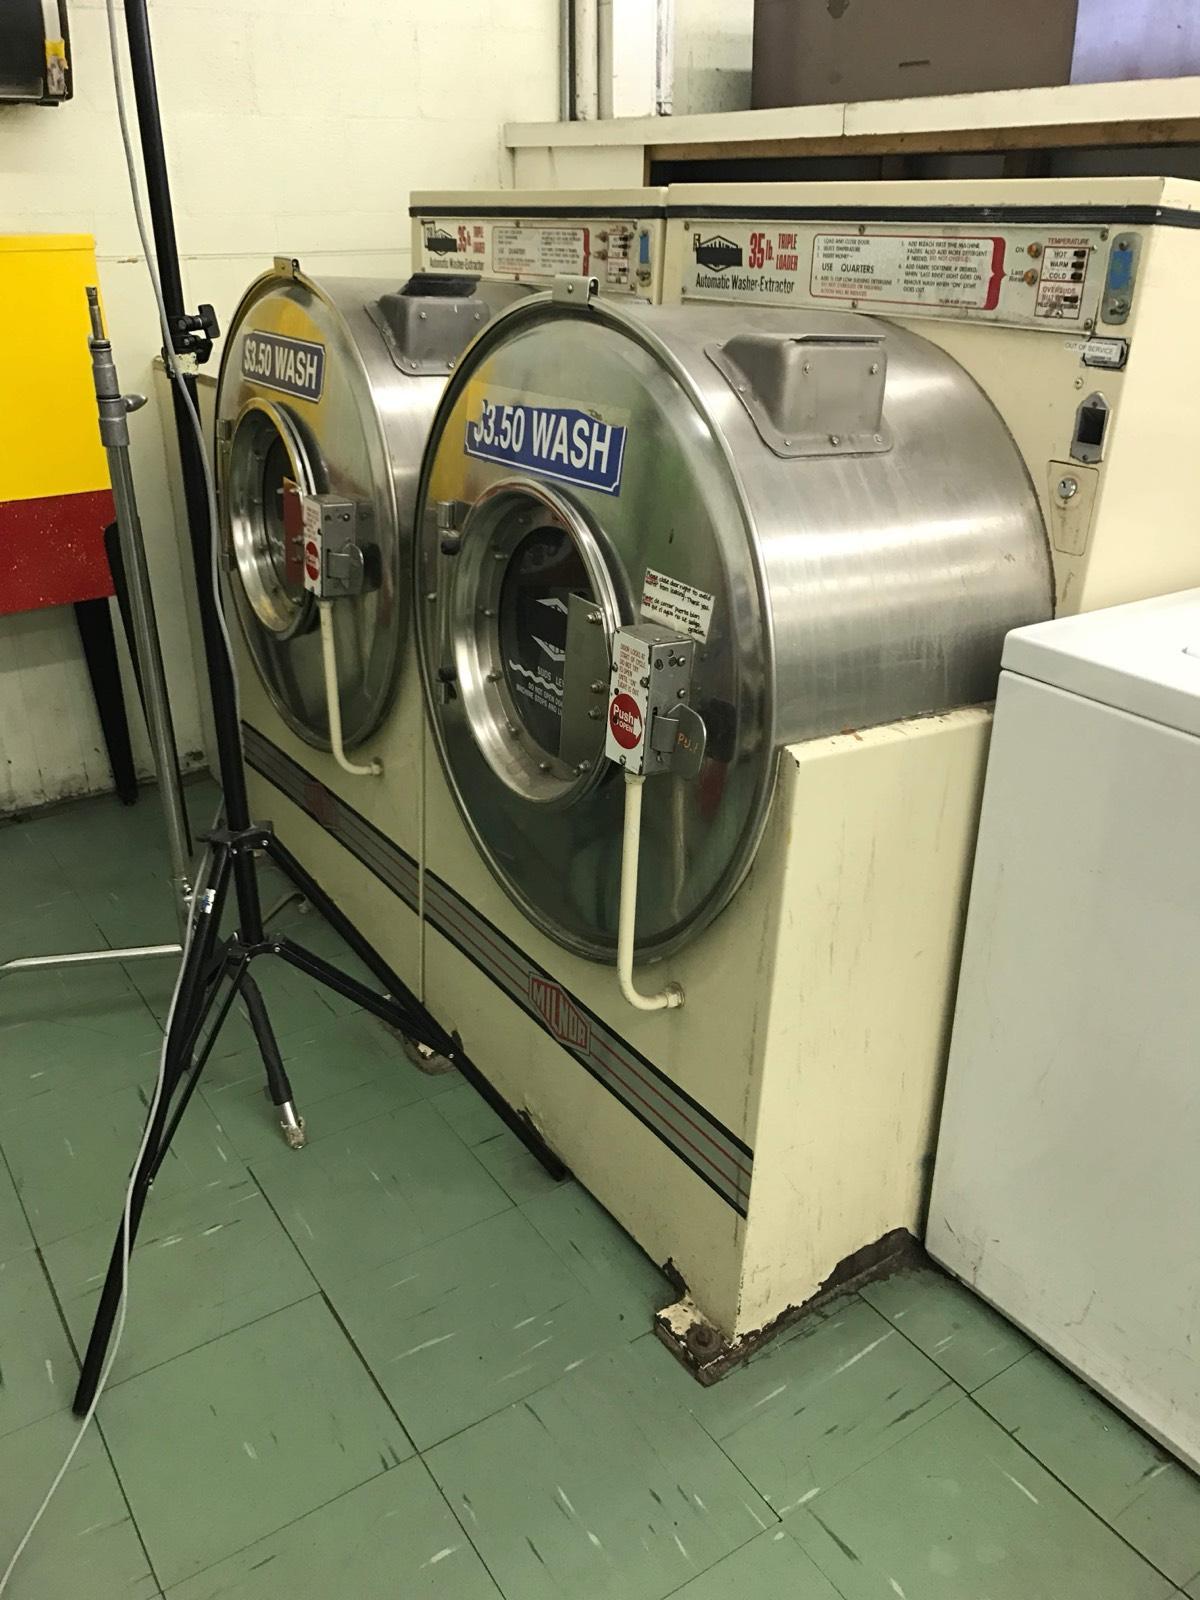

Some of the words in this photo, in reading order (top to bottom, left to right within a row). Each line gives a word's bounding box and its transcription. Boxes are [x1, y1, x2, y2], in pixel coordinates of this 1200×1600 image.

[778, 233, 798, 249] TRIPLE
[749, 233, 765, 268] 35
[766, 240, 774, 260] lb.
[776, 255, 798, 271] LOADER
[822, 263, 833, 272] USE
[841, 264, 874, 274] QUARTERS
[696, 272, 730, 289] Automatic
[732, 274, 794, 294] Washer-Extractor
[1043, 286, 1076, 294] OVERSUDS
[1087, 344, 1113, 353] SERVICE
[244, 338, 271, 376] $3.50
[275, 346, 317, 389] WASH
[533, 410, 612, 473] WASH
[613, 703, 634, 724] Push
[619, 722, 633, 734] OPEN
[533, 981, 585, 1046] MILNOR
